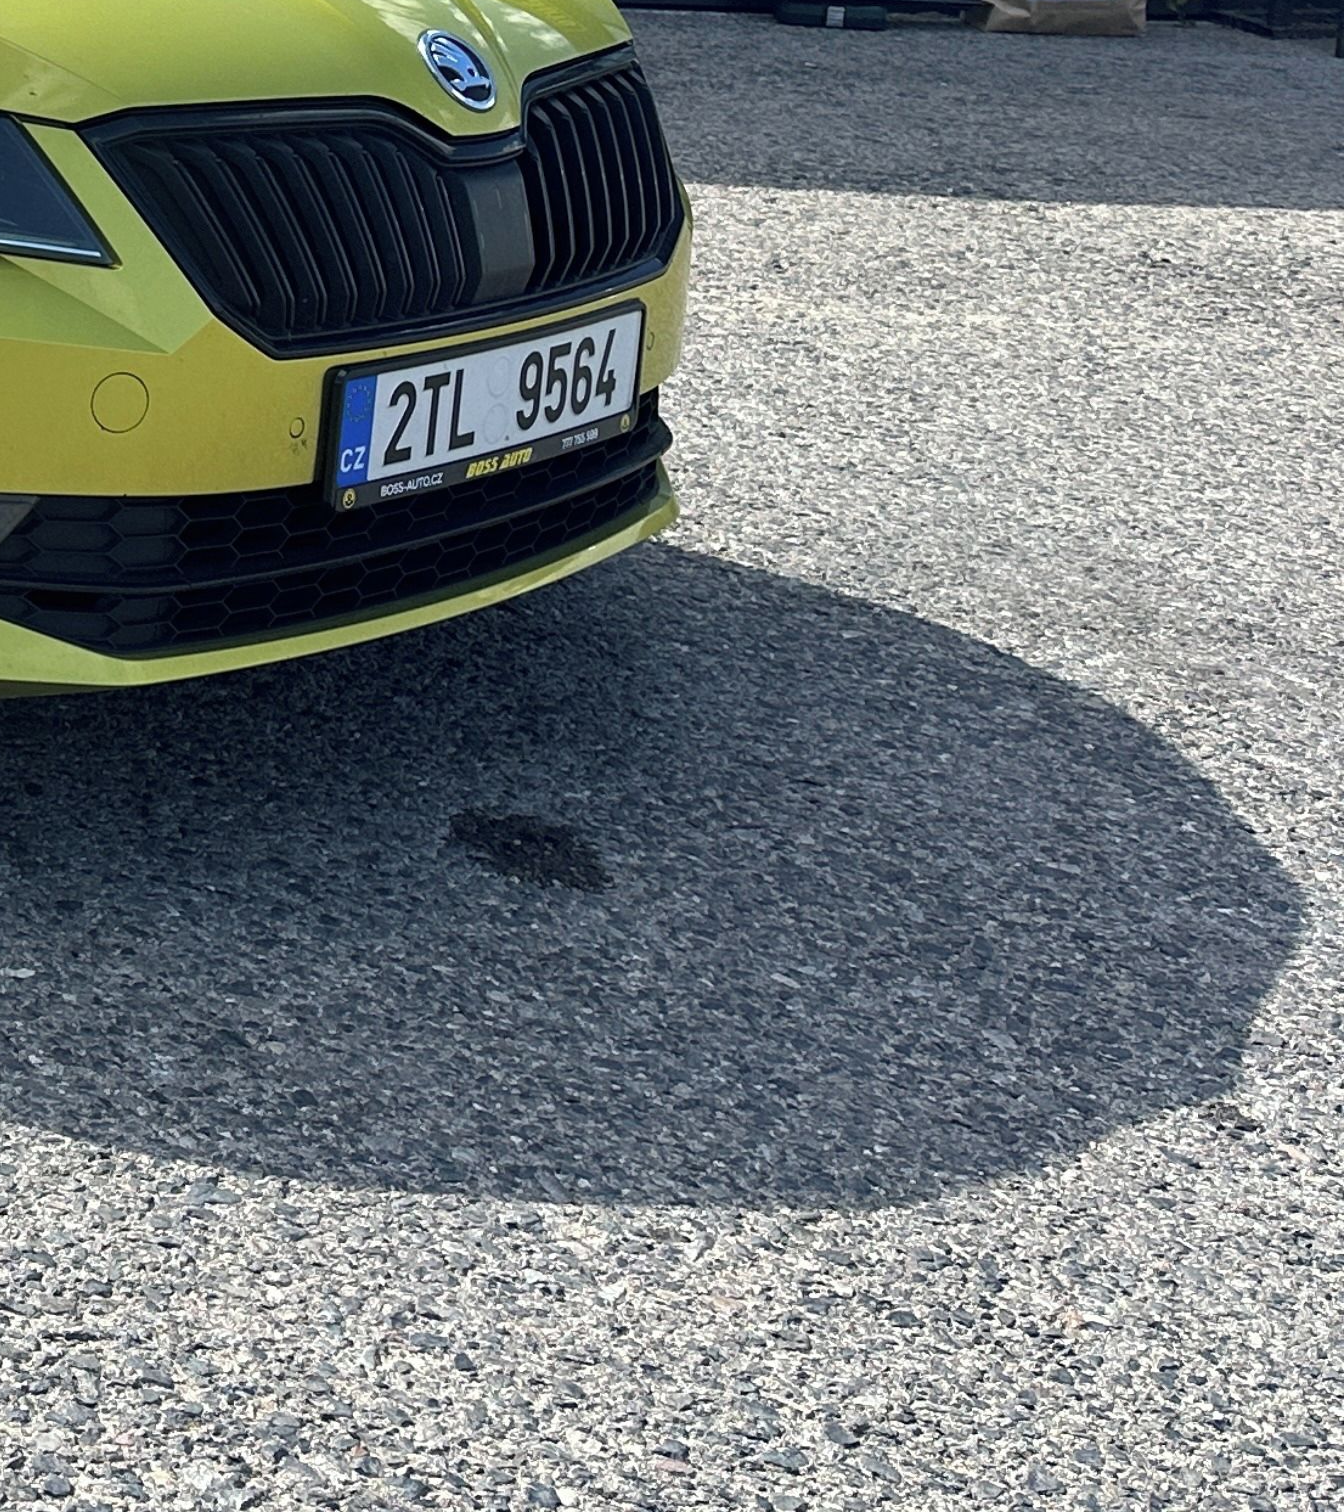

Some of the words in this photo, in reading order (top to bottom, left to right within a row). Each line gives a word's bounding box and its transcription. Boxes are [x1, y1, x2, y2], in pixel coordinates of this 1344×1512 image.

[382, 369, 476, 466] 2TL
[516, 329, 617, 431] 9564
[340, 446, 366, 474] CZ
[466, 453, 498, 479] BOSS
[499, 446, 533, 471] AUTO
[380, 472, 444, 497] BOSS-AUTO.CZ
